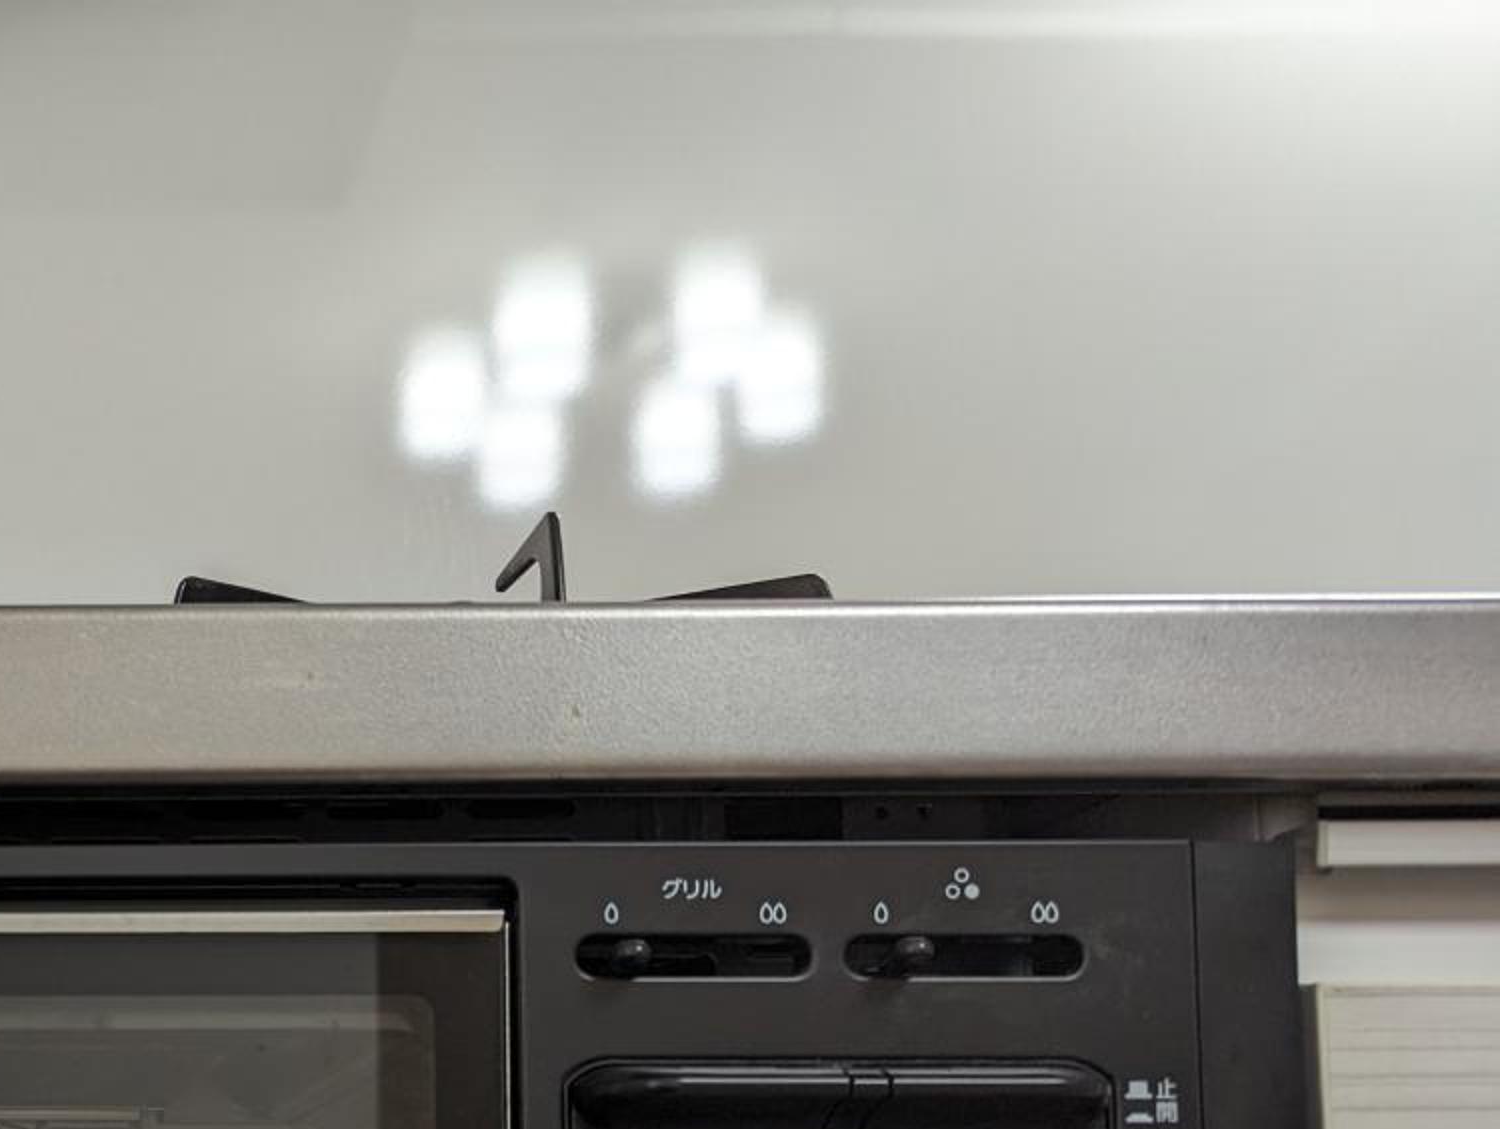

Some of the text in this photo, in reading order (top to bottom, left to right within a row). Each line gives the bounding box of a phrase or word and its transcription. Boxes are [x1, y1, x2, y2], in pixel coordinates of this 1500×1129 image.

[661, 877, 722, 900] グリル
[1155, 1077, 1178, 1100] 止
